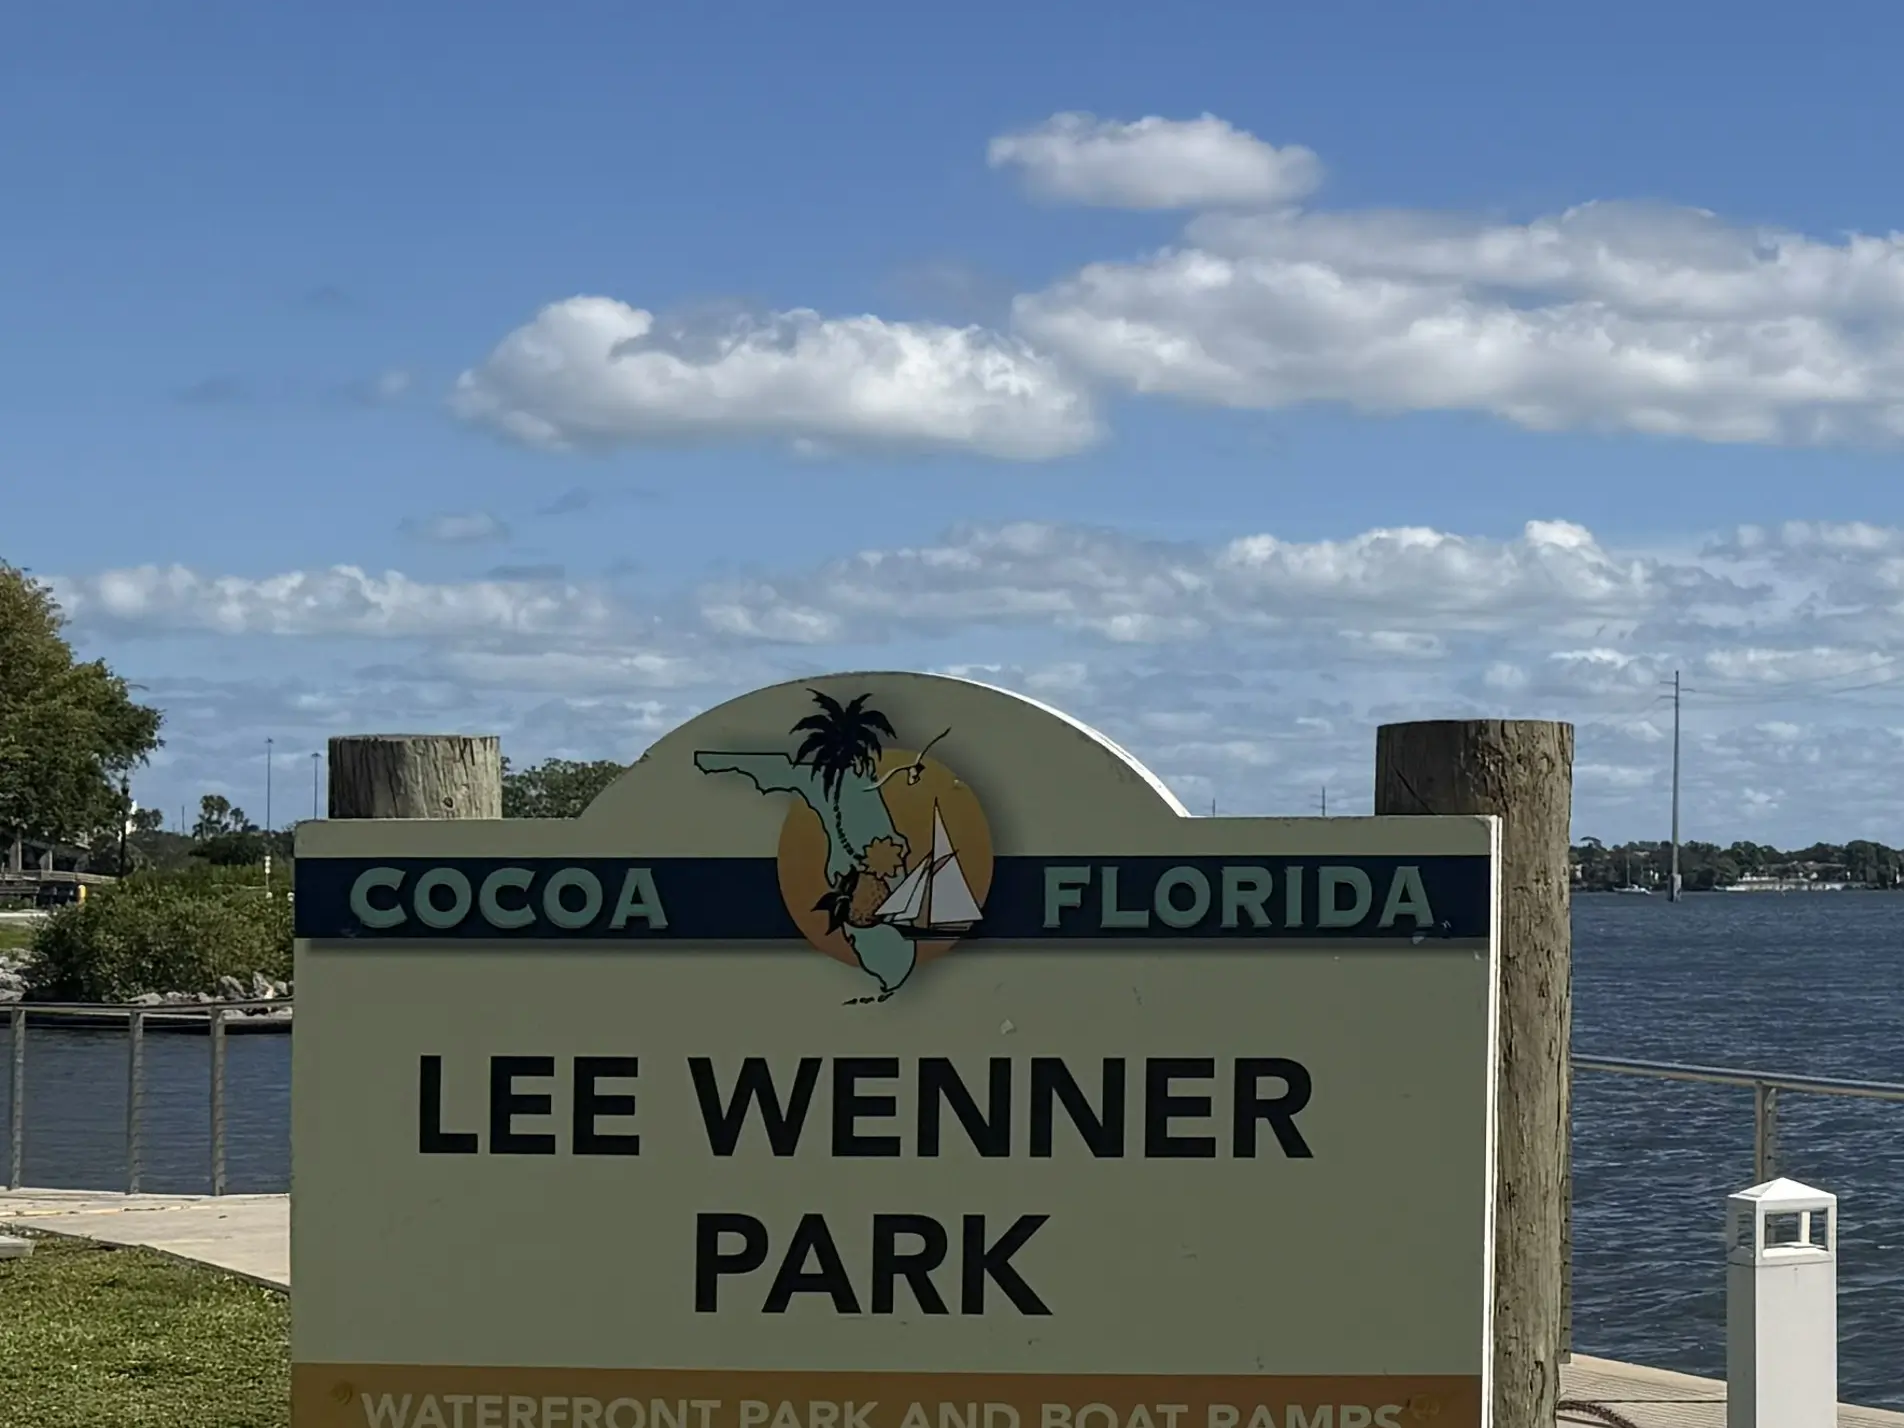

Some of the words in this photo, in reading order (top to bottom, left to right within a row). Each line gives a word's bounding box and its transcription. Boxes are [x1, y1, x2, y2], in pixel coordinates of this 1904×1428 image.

[349, 866, 670, 930] COCOA
[1042, 865, 1436, 929] FLORIDA
[418, 1054, 641, 1156] LEE
[687, 1056, 1315, 1159] WENNER
[694, 1212, 1054, 1316] PARK
